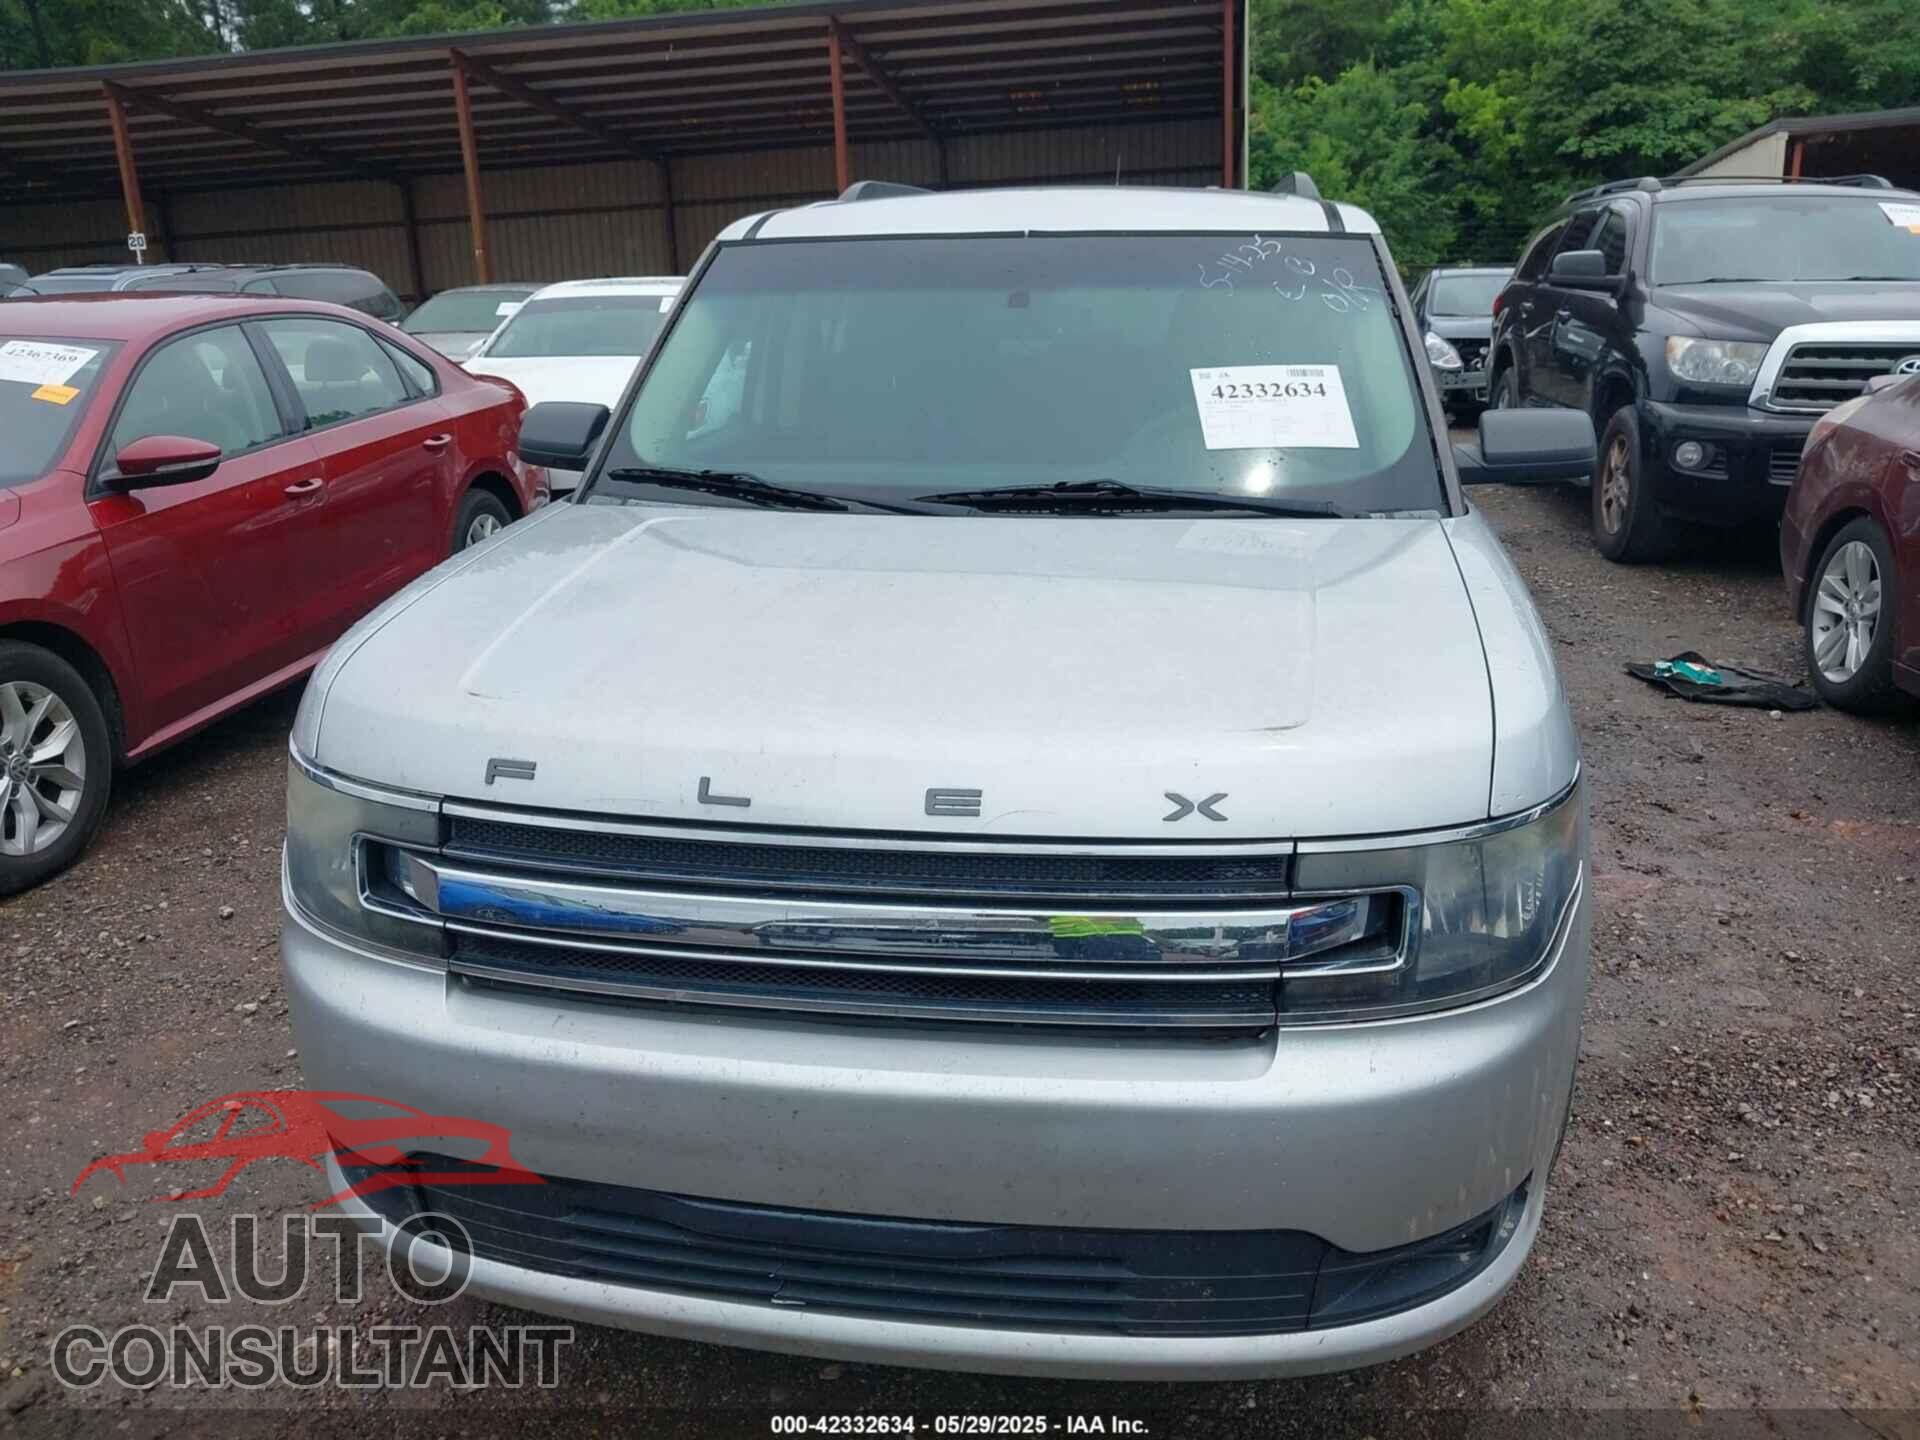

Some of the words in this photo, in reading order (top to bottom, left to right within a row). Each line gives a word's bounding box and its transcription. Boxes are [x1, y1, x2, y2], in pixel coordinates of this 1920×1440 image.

[128, 236, 144, 247] 20
[1210, 381, 1327, 400] 42332634
[485, 758, 1228, 821] FLEX
